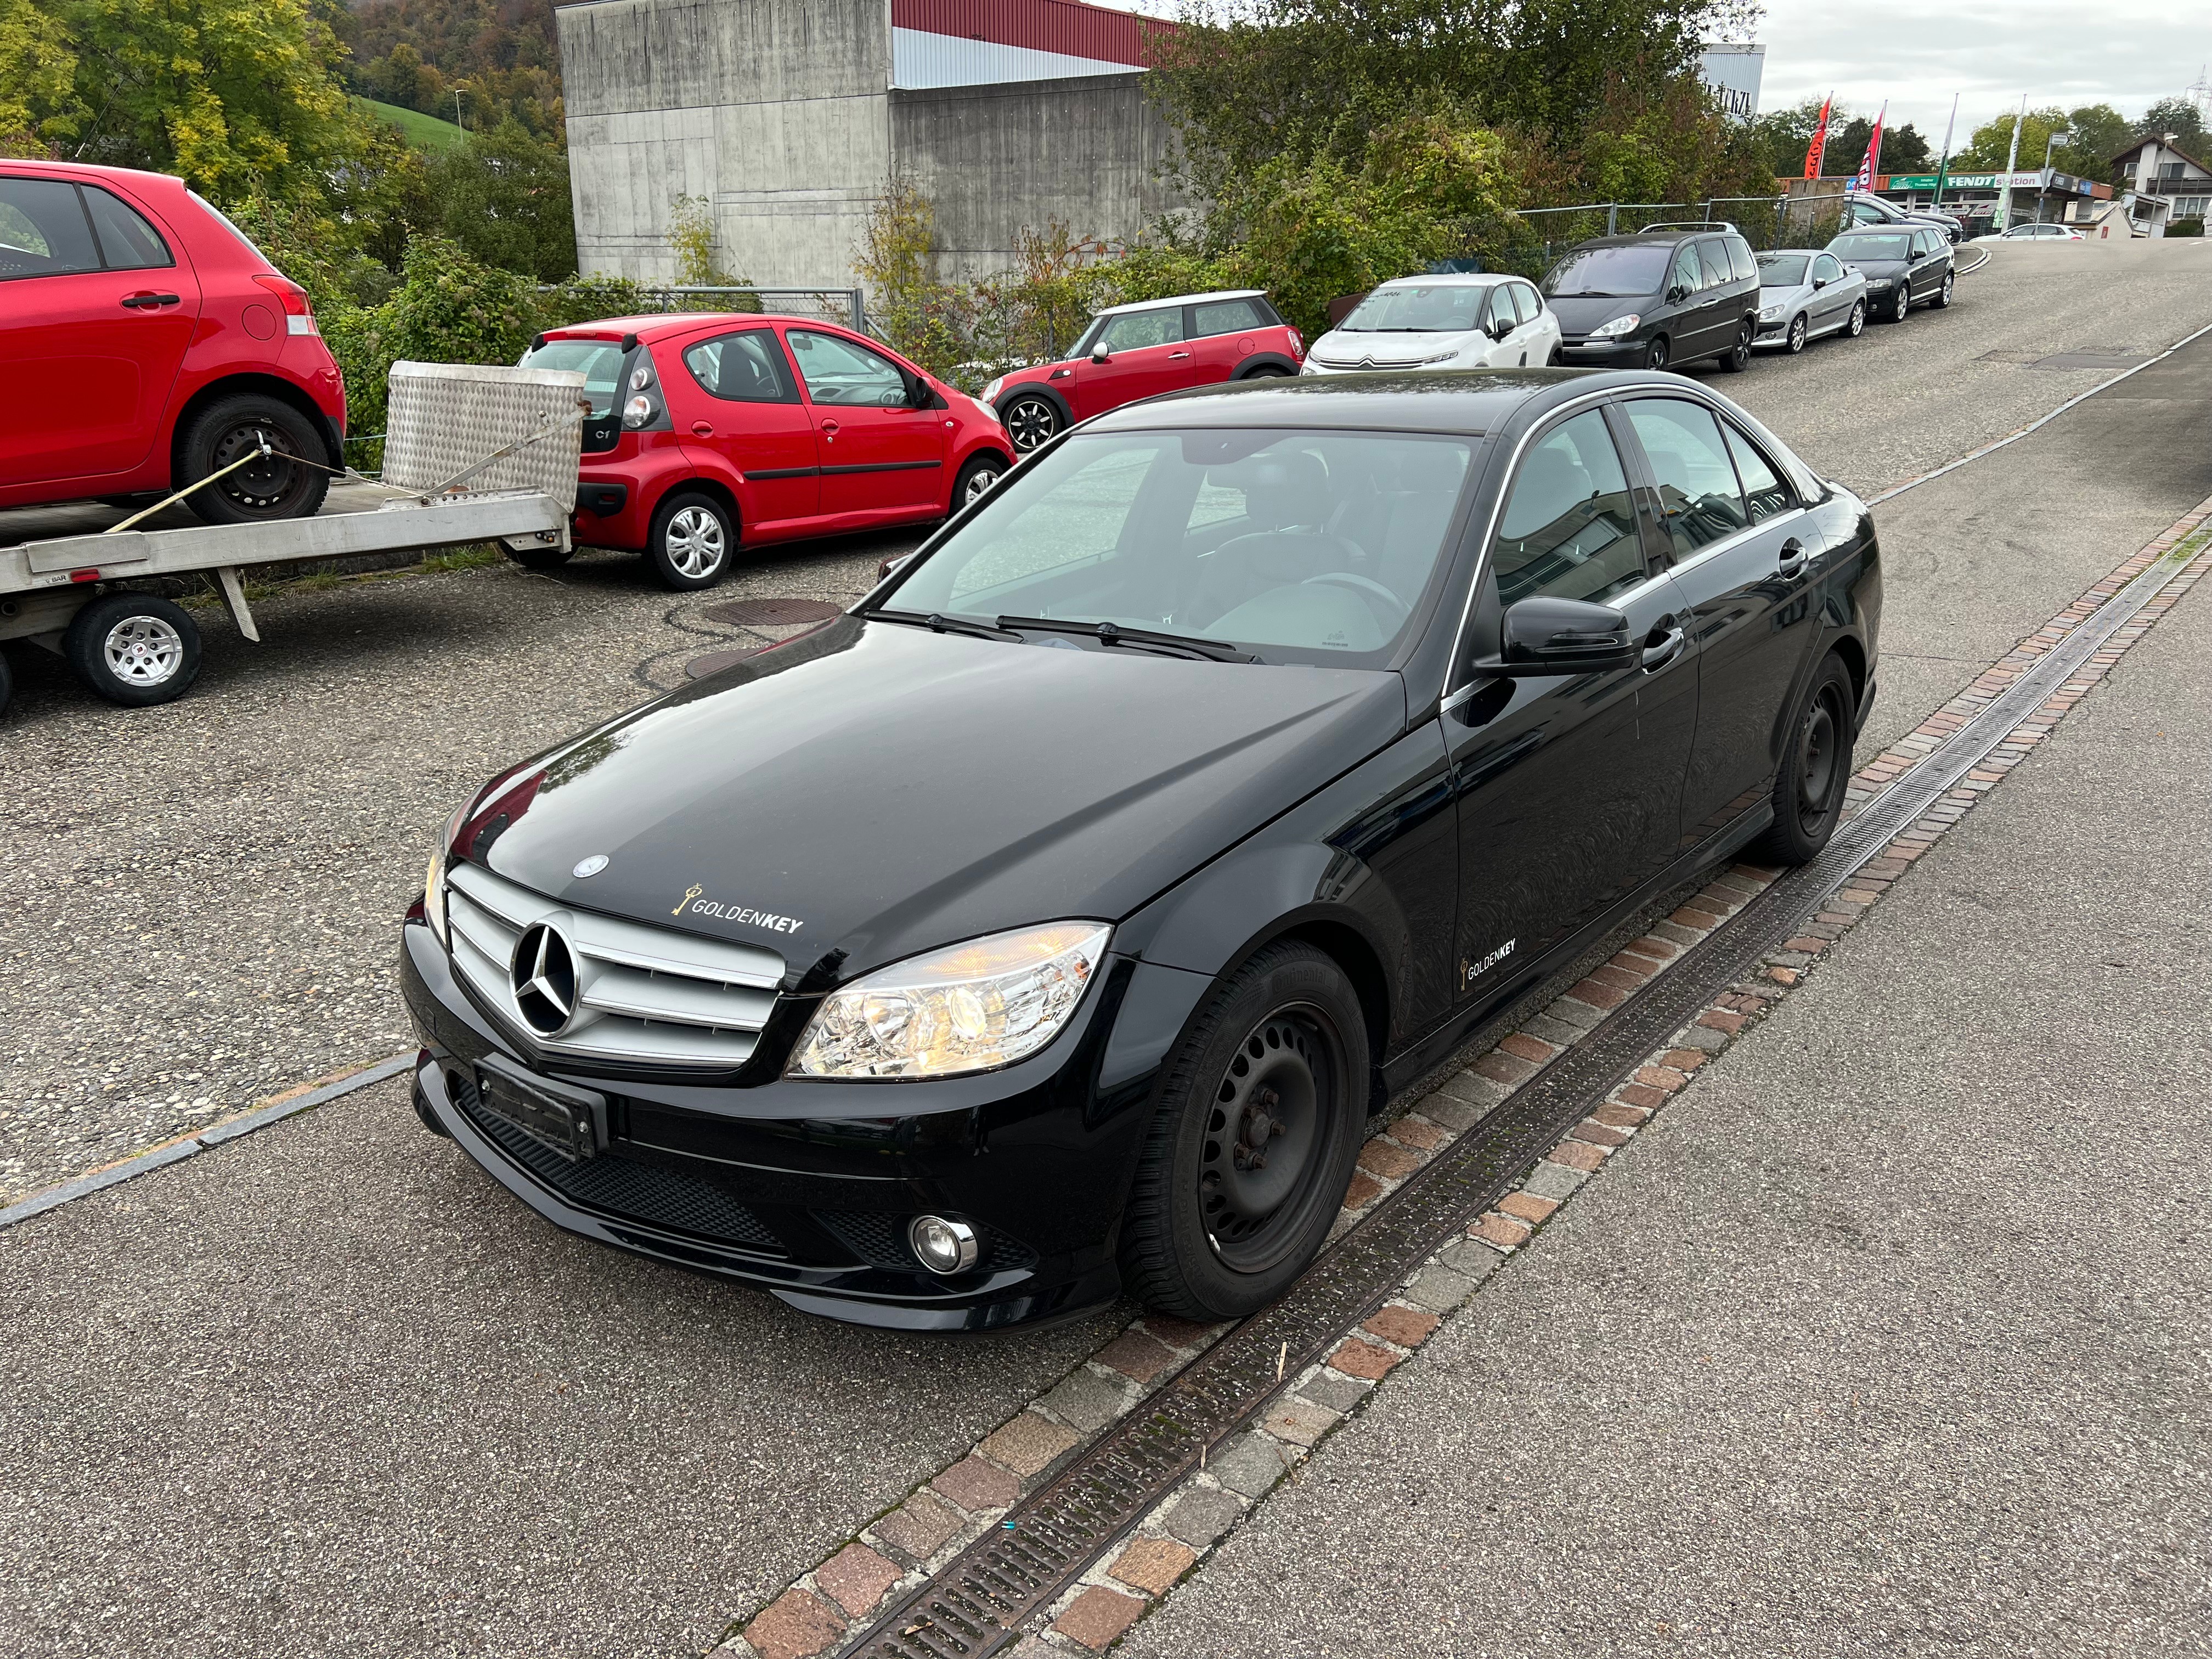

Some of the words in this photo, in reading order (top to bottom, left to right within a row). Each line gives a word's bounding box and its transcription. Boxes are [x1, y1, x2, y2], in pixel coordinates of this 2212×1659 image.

[1948, 176, 1995, 187] FENDT
[197, 412, 224, 446] UNIROYAL
[595, 430, 610, 439] C1
[692, 899, 804, 934] GOLDENKEY
[1468, 938, 1516, 980] GOLDENKEY
[1272, 967, 1327, 994] Continental
